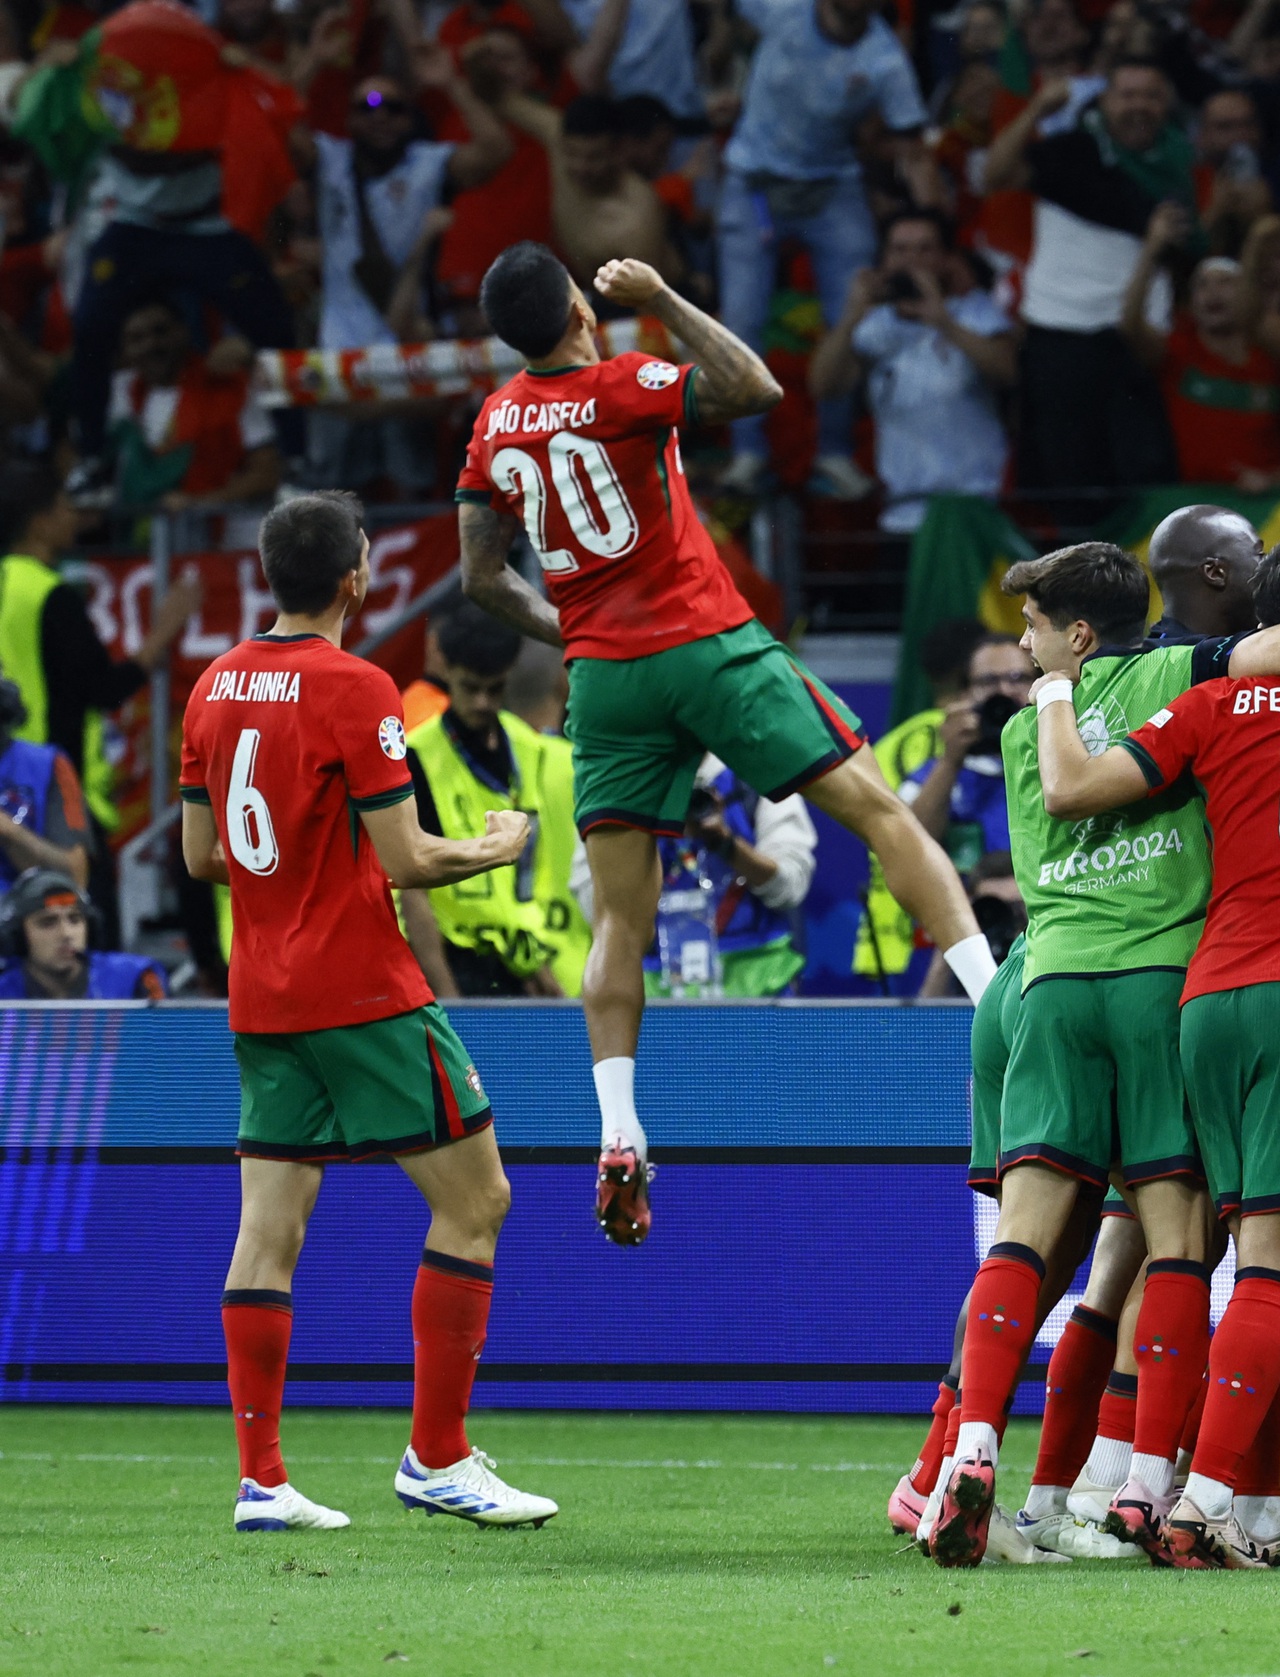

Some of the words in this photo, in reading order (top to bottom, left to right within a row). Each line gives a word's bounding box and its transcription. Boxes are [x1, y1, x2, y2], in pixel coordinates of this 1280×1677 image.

[483, 399, 520, 441] JÃO
[490, 431, 639, 575] 20
[206, 670, 301, 703] J.PALHINHA
[225, 728, 280, 877] 6
[1037, 828, 1183, 887] EURO2024
[1064, 865, 1150, 896] GERMANY
